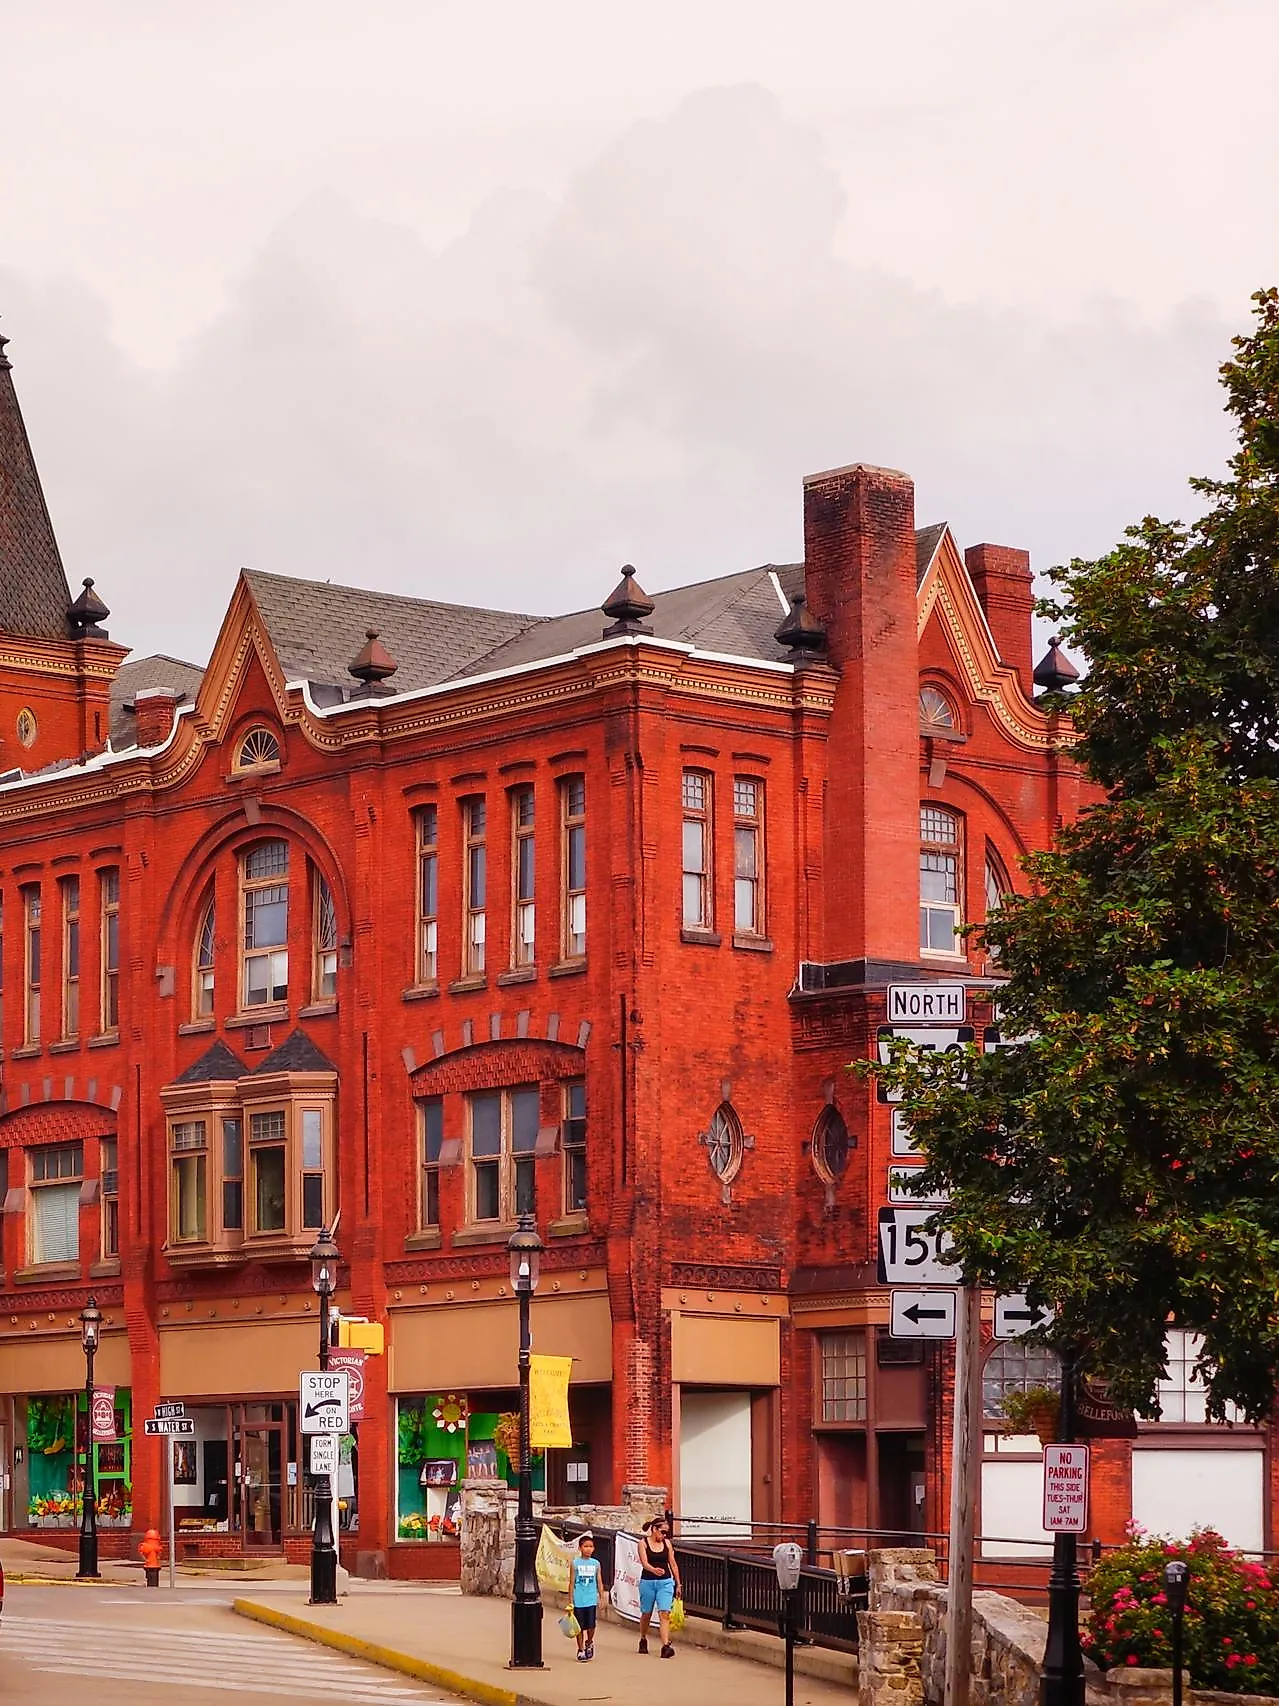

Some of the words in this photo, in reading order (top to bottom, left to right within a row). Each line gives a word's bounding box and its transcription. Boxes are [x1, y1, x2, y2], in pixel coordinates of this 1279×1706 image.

[894, 990, 959, 1016] NORTH
[328, 1357, 364, 1367] VICTORIAN
[308, 1377, 341, 1389] STOP
[314, 1390, 335, 1398] HERE
[161, 1405, 175, 1417] HIGH
[157, 1421, 181, 1433] WATER
[181, 1423, 187, 1431] ST
[320, 1416, 344, 1428] RED
[315, 1439, 332, 1448] FORM
[313, 1450, 334, 1460] SINGLE
[1060, 1452, 1072, 1465] NO
[315, 1462, 332, 1472] LANE
[1048, 1467, 1083, 1480] PARKING
[1050, 1483, 1065, 1492] THIS
[1066, 1483, 1081, 1492] SIDE
[1059, 1506, 1071, 1514] SAT
